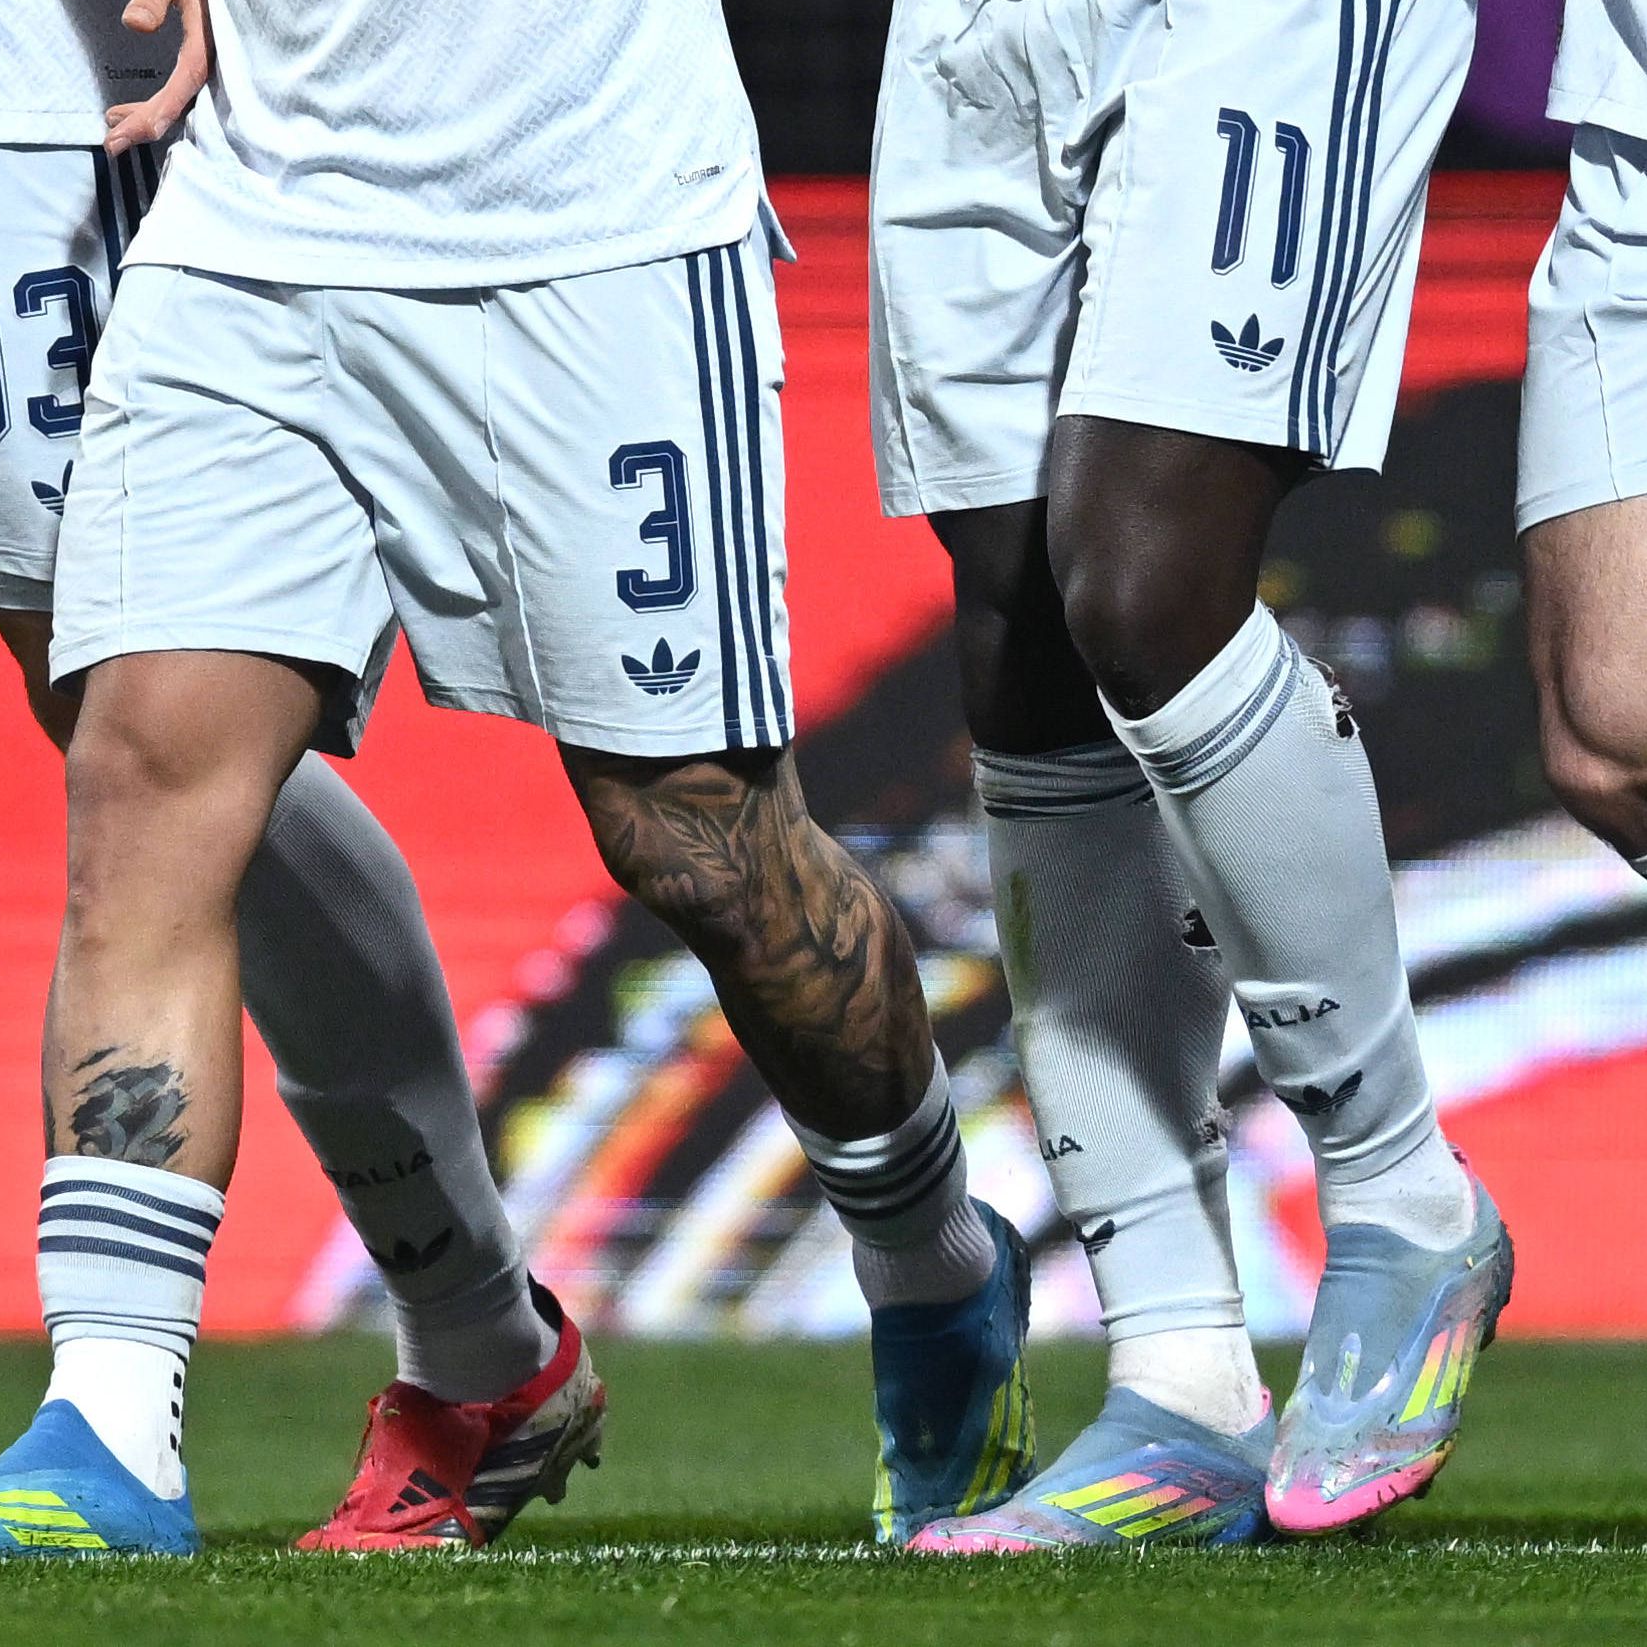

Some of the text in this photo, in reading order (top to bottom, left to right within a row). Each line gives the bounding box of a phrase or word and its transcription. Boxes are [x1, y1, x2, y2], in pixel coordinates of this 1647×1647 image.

[1211, 107, 1312, 290] 11
[609, 439, 699, 614] 3
[1248, 997, 1341, 1029] ALIA
